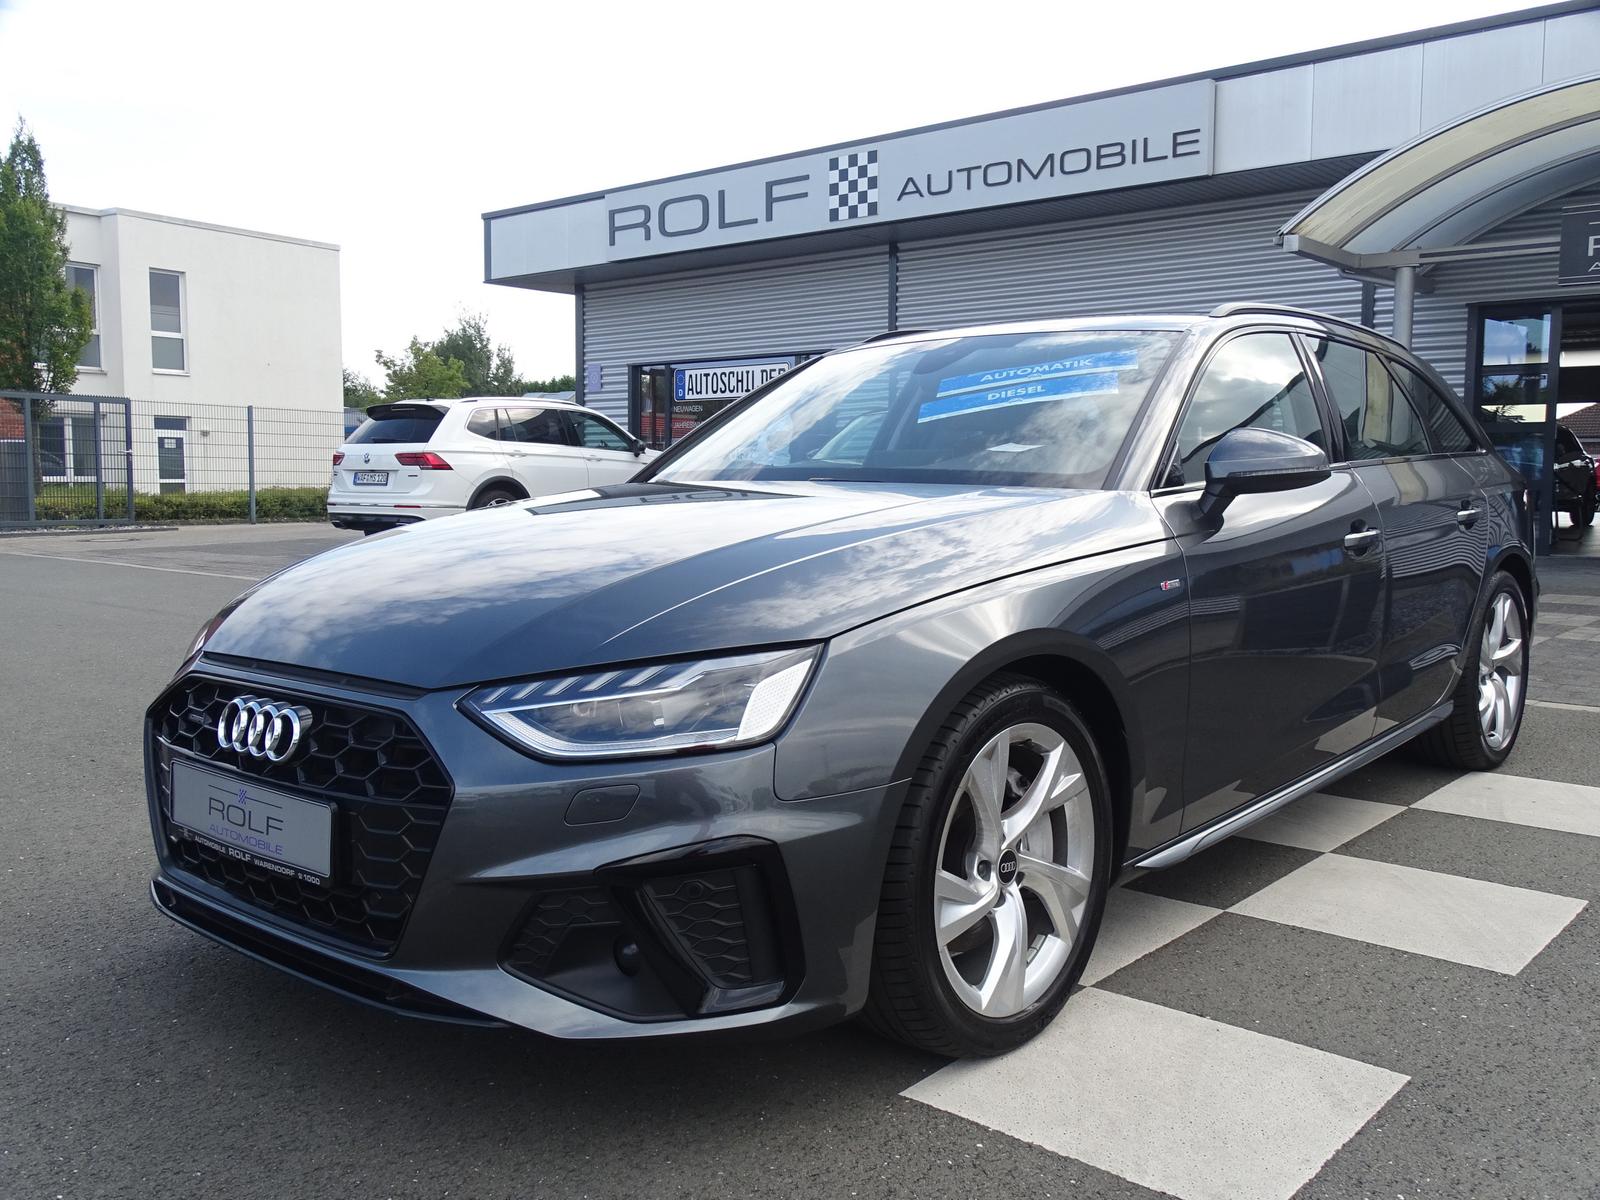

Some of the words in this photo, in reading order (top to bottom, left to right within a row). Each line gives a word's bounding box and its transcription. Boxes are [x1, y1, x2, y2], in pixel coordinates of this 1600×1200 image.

[608, 174, 809, 247] ROLF
[897, 129, 1201, 202] AUTOMOBILE
[980, 358, 1093, 382] AUTOMATIK
[678, 389, 683, 397] D
[987, 384, 1046, 401] DIESEL
[673, 405, 703, 413] NEUWAGEN
[208, 797, 284, 836] ROLF
[209, 823, 284, 856] AUTOMOBILE
[228, 847, 252, 862] ROLF
[254, 858, 296, 877] WARENDORF
[303, 873, 321, 886] 1000
